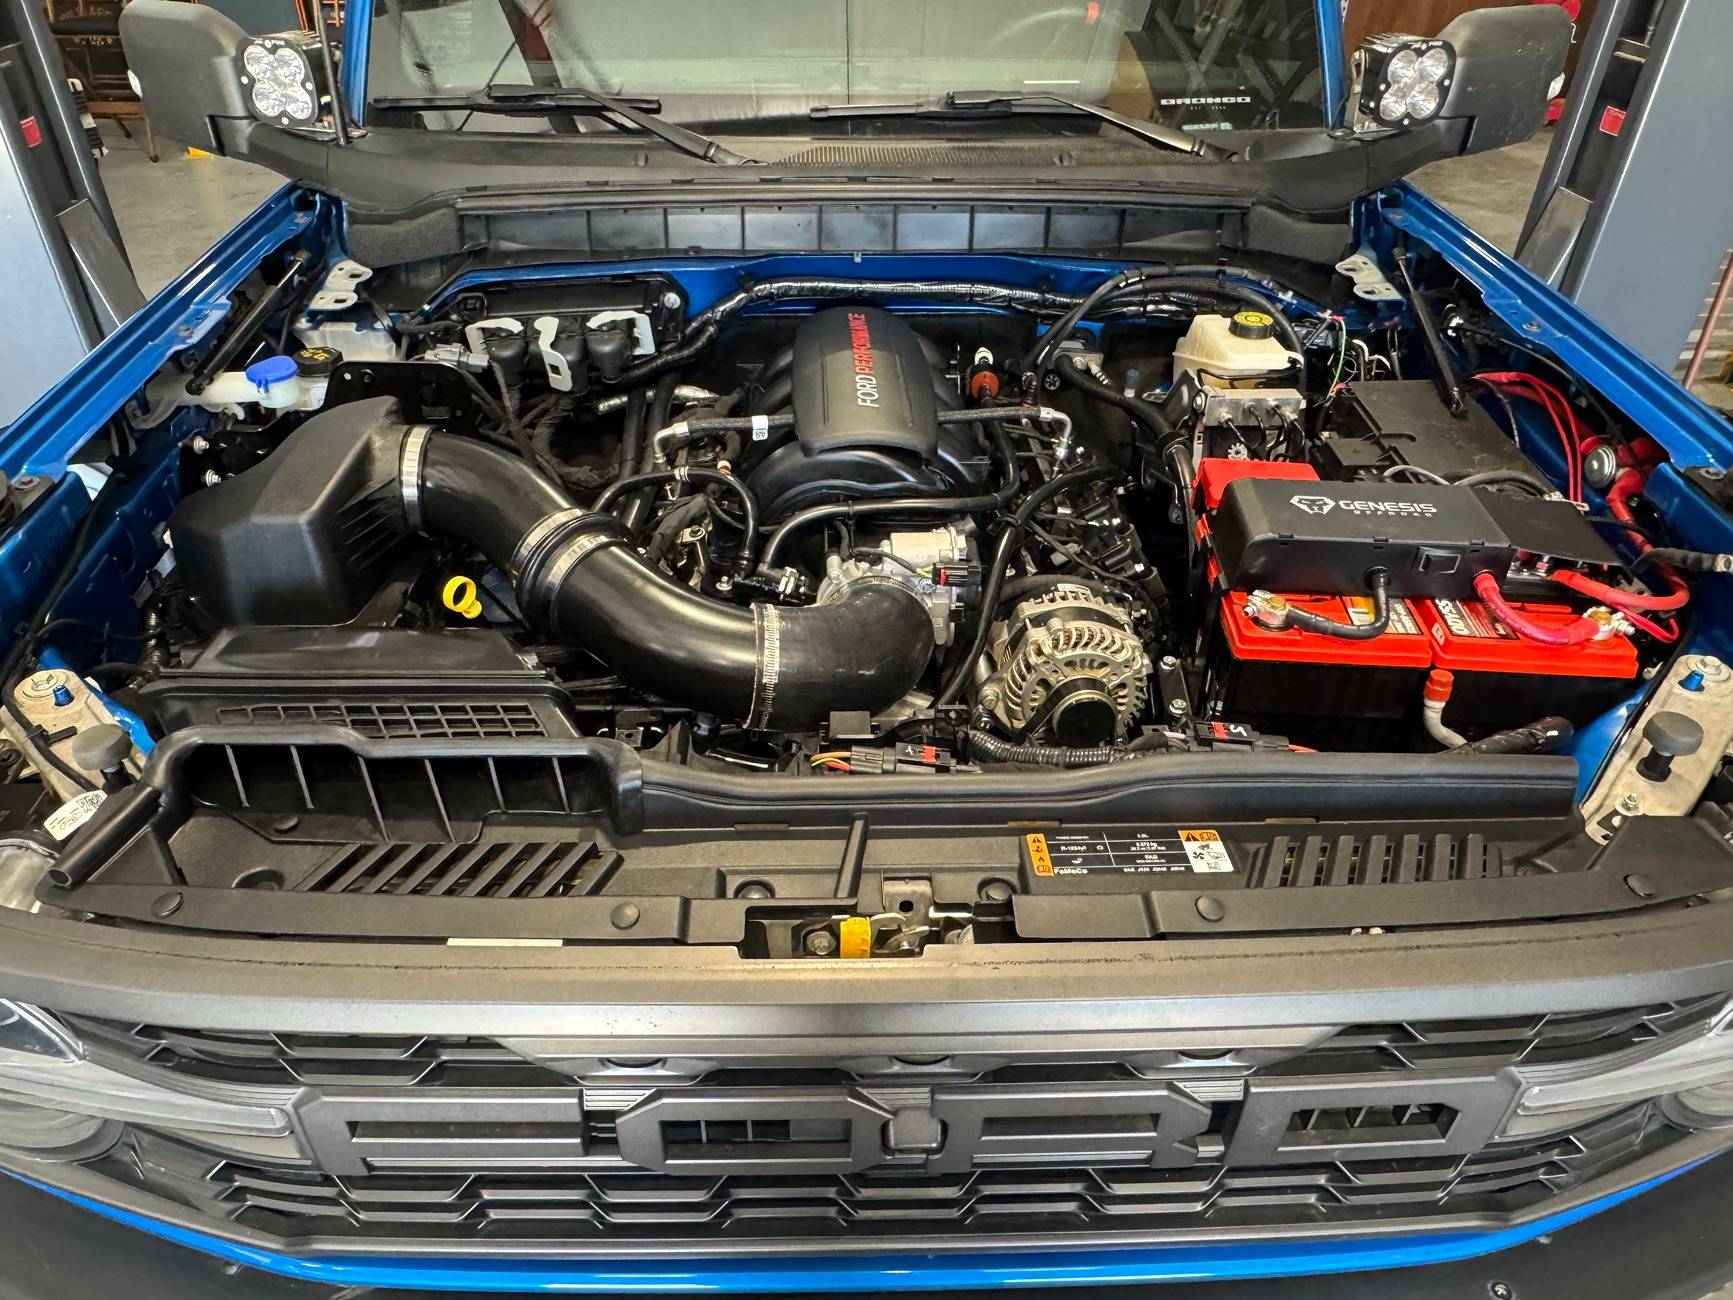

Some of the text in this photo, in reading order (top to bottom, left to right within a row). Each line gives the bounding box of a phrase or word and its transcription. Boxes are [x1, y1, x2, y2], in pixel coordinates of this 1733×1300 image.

[1161, 97, 1251, 106] BRONCO
[856, 374, 880, 408] FORD
[1338, 499, 1438, 513] GENESIS
[291, 1066, 1524, 1176] FORD
